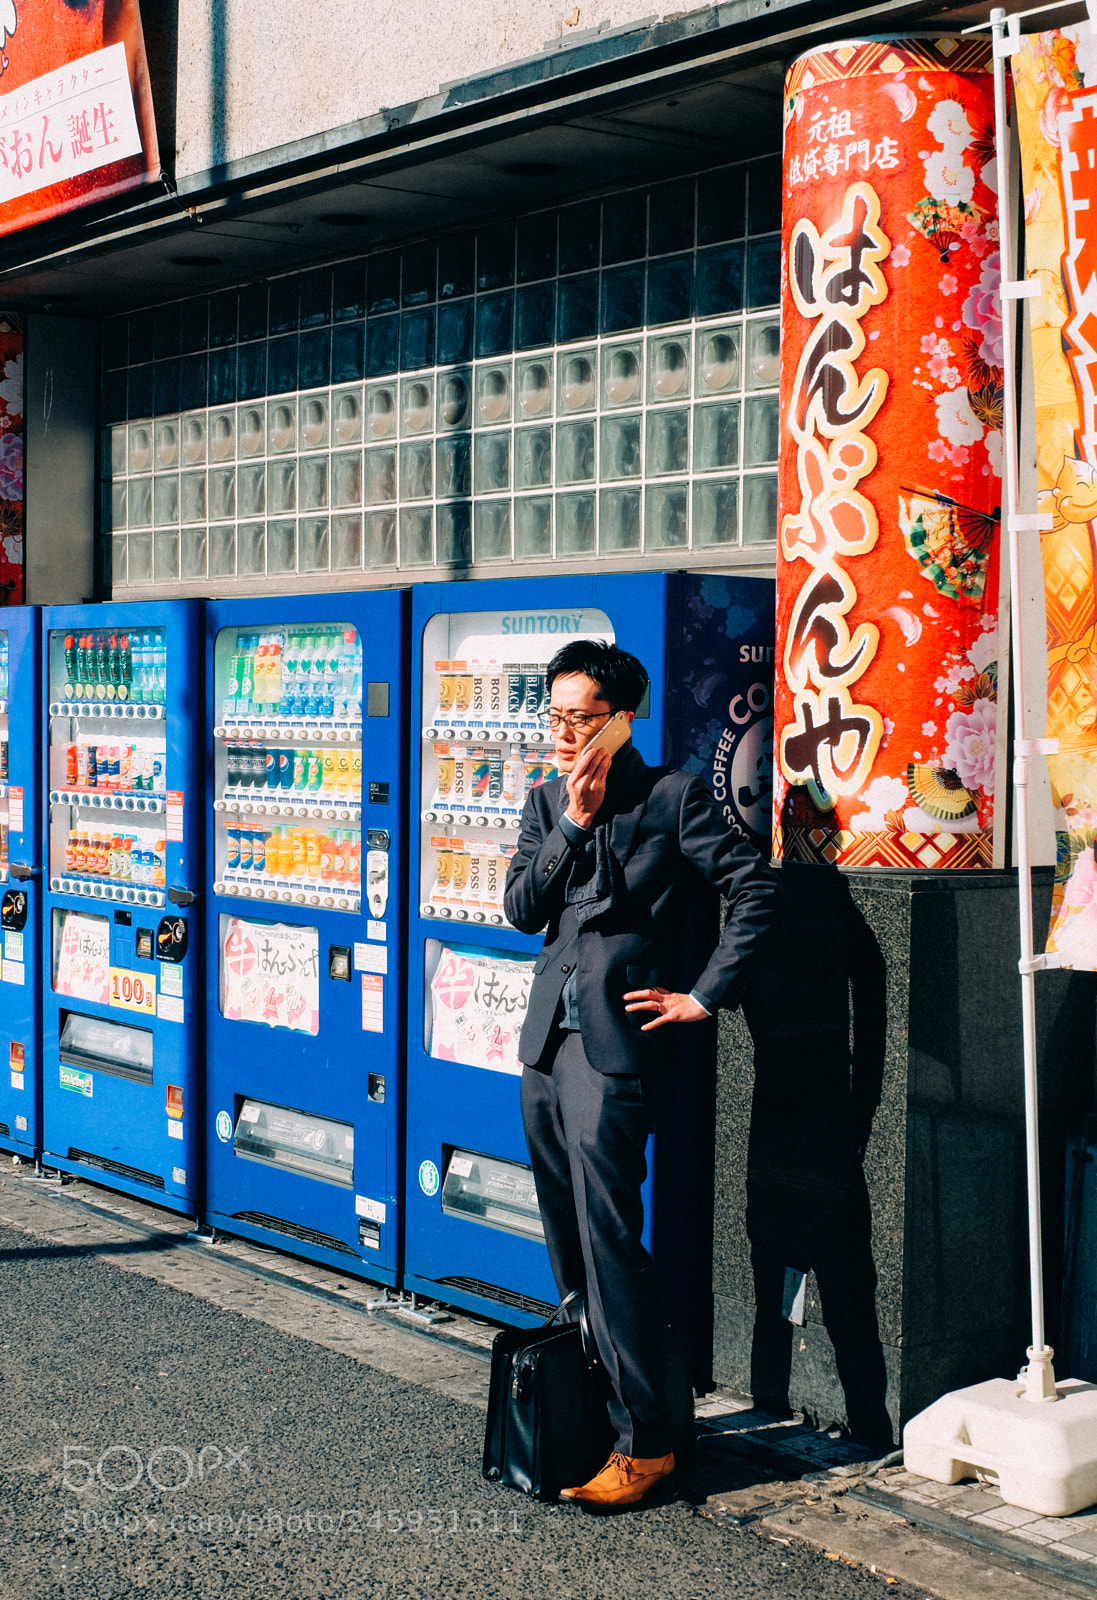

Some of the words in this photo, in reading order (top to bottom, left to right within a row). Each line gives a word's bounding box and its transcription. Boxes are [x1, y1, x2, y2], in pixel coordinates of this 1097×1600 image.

[807, 106, 856, 144] 元祖
[788, 136, 900, 187] 低貸専門店
[502, 614, 583, 634] SUNTORY
[474, 677, 483, 710] BOSS
[491, 678, 500, 711] BOSS
[509, 676, 519, 712] BLACK
[527, 676, 538, 713] BLACK
[455, 762, 464, 794] BOSS
[489, 761, 500, 796] BLACK
[712, 727, 736, 802] COFFEE
[470, 858, 480, 890] BOSS
[487, 859, 497, 892] BOSS
